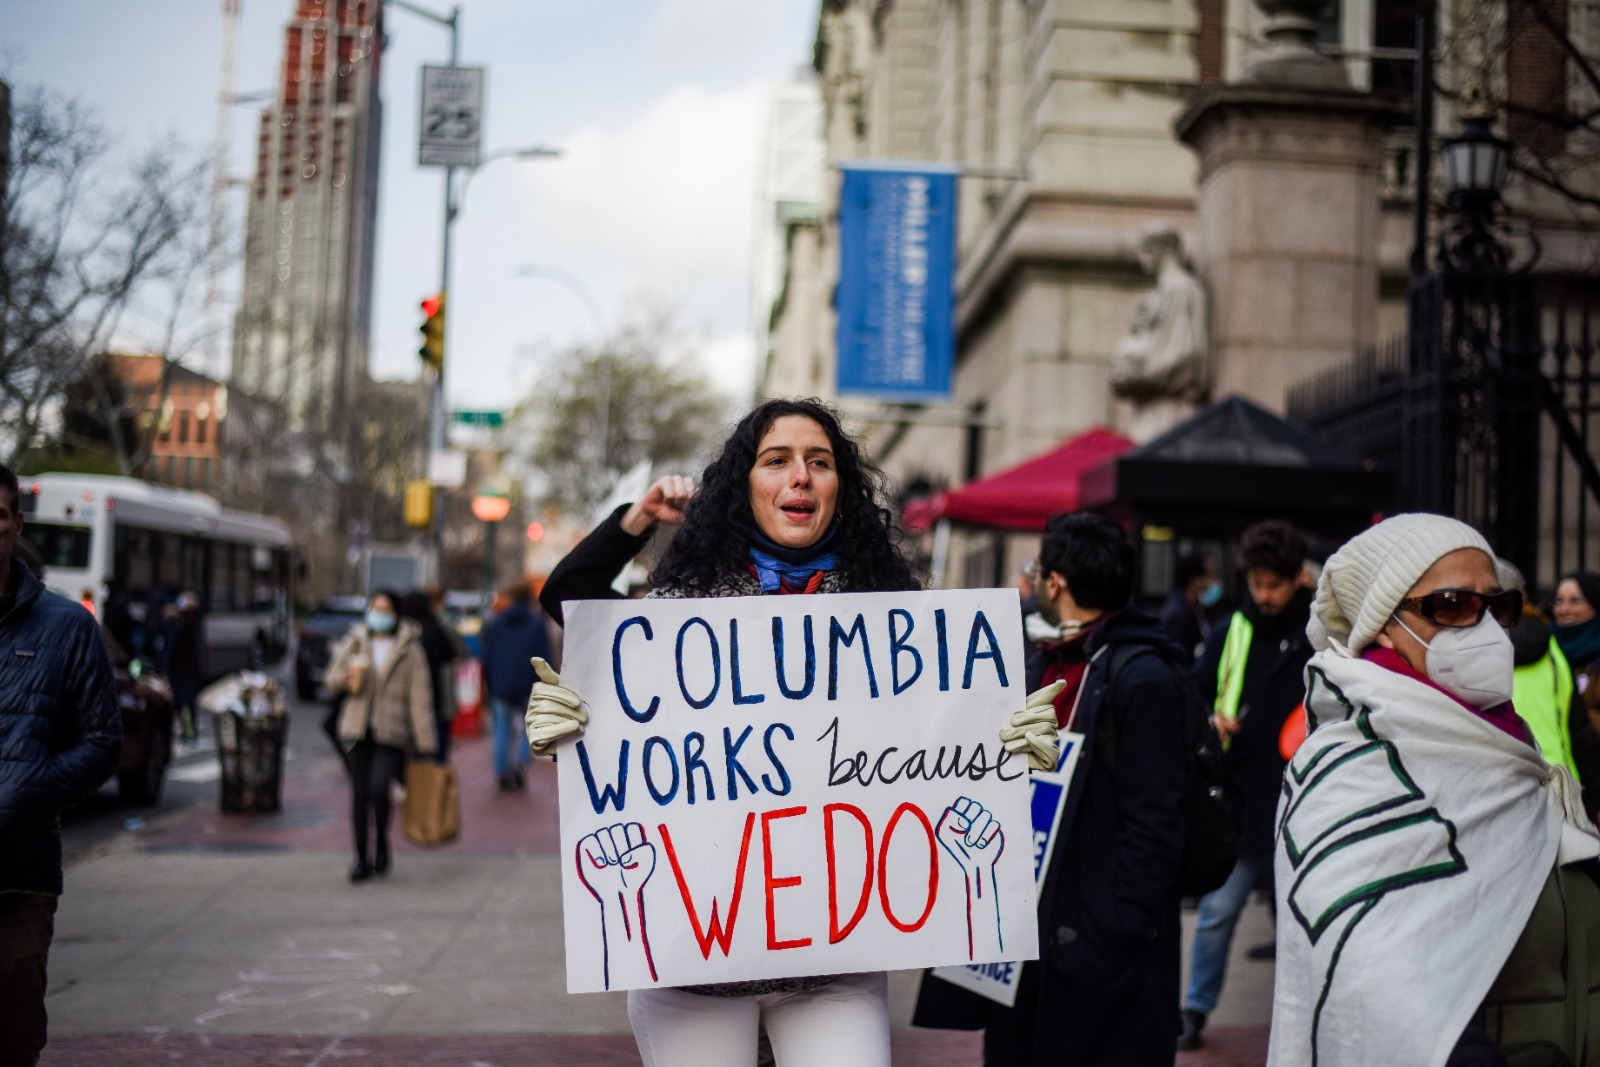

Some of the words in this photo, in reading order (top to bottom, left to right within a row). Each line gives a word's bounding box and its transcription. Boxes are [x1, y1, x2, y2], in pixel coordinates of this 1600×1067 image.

[425, 104, 476, 139] 25
[611, 608, 1010, 724] COLUMBIA
[576, 722, 795, 815] WORKS
[816, 717, 1025, 787] because
